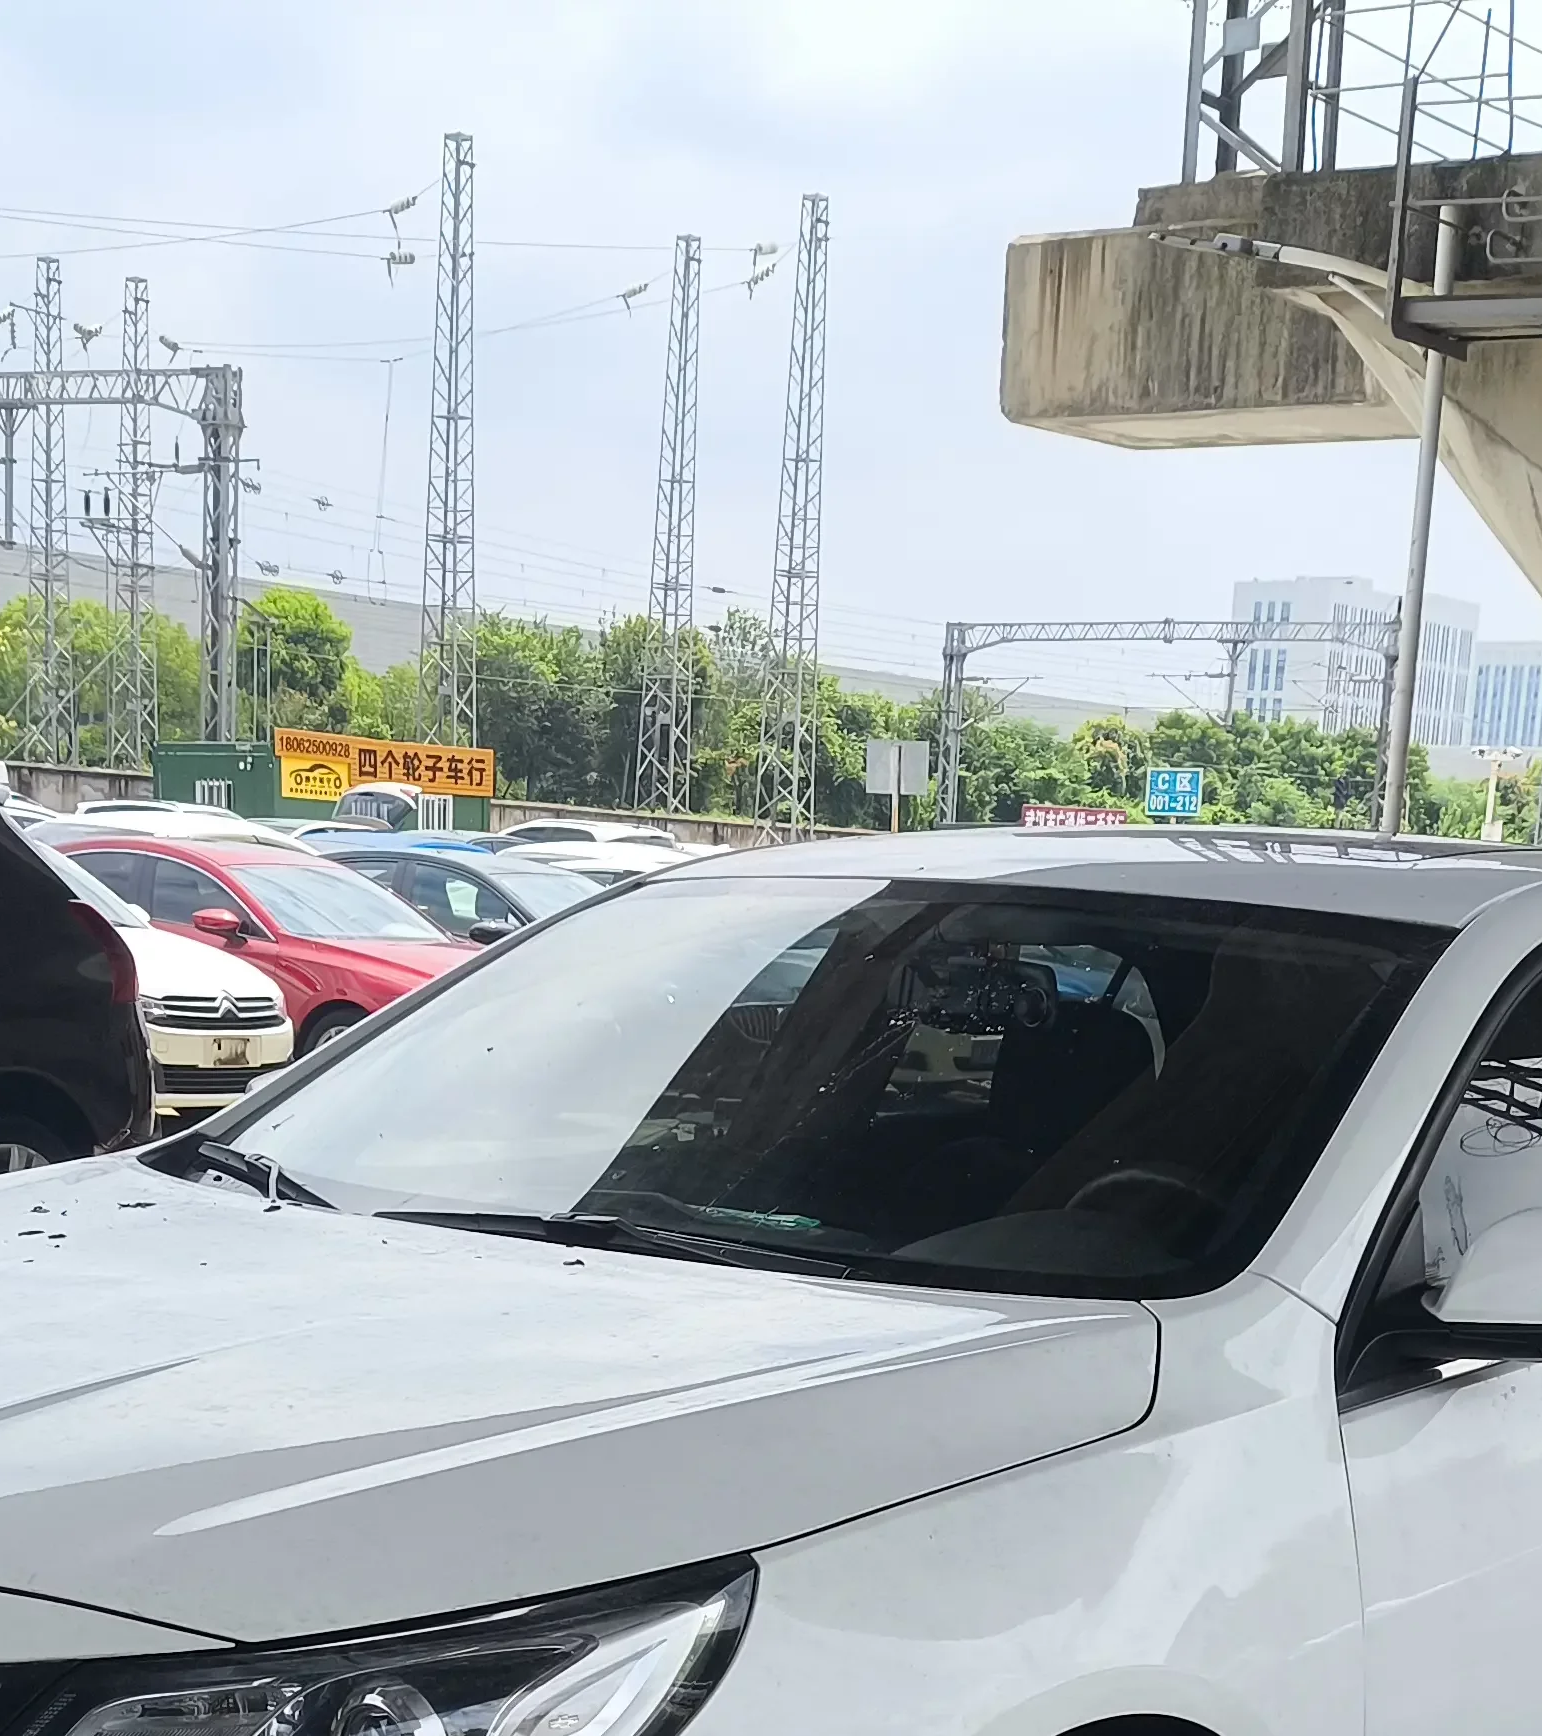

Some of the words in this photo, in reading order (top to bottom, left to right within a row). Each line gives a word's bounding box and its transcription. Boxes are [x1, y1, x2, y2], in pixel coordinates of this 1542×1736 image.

[279, 736, 351, 758] 18062500928
[358, 748, 487, 787] 四个轮子车行
[1149, 795, 1197, 811] 001-212
